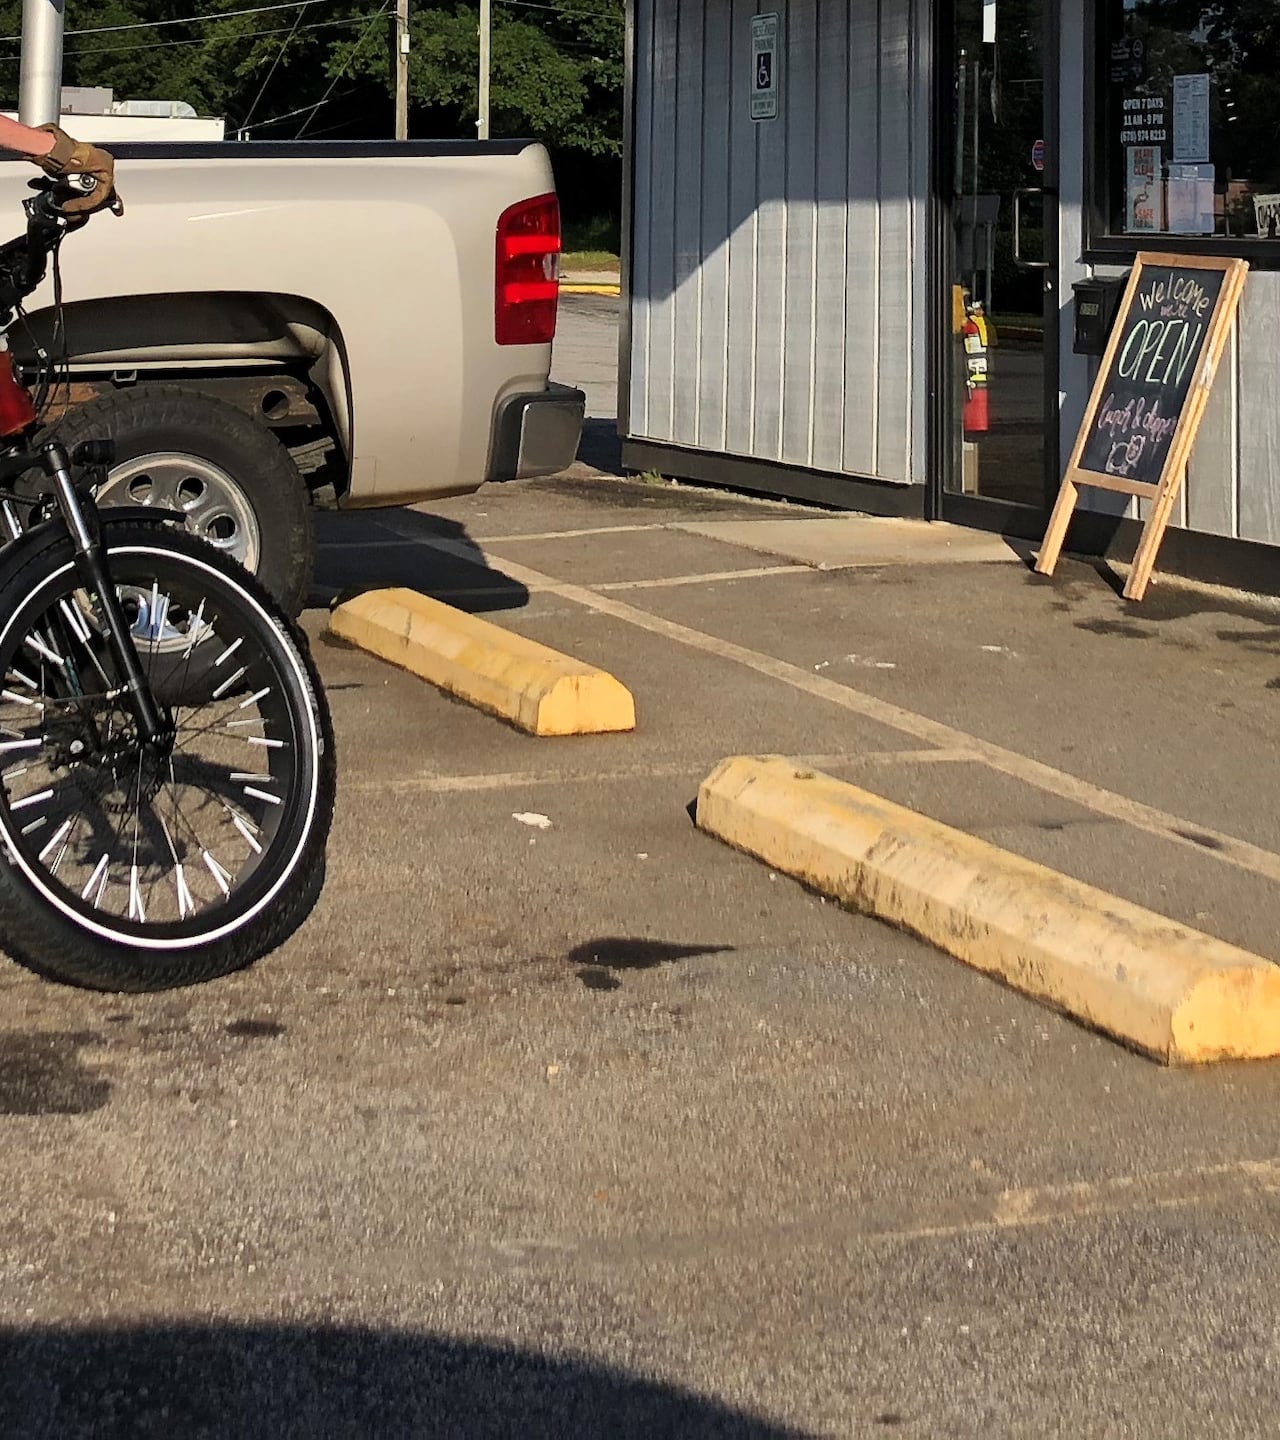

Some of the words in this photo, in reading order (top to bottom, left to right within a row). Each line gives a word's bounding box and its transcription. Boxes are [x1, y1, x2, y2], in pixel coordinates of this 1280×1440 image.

[1123, 99, 1141, 110] OPEN
[1147, 97, 1164, 109] DAYS
[1152, 113, 1164, 124] PM
[1118, 319, 1201, 386] OPEN
